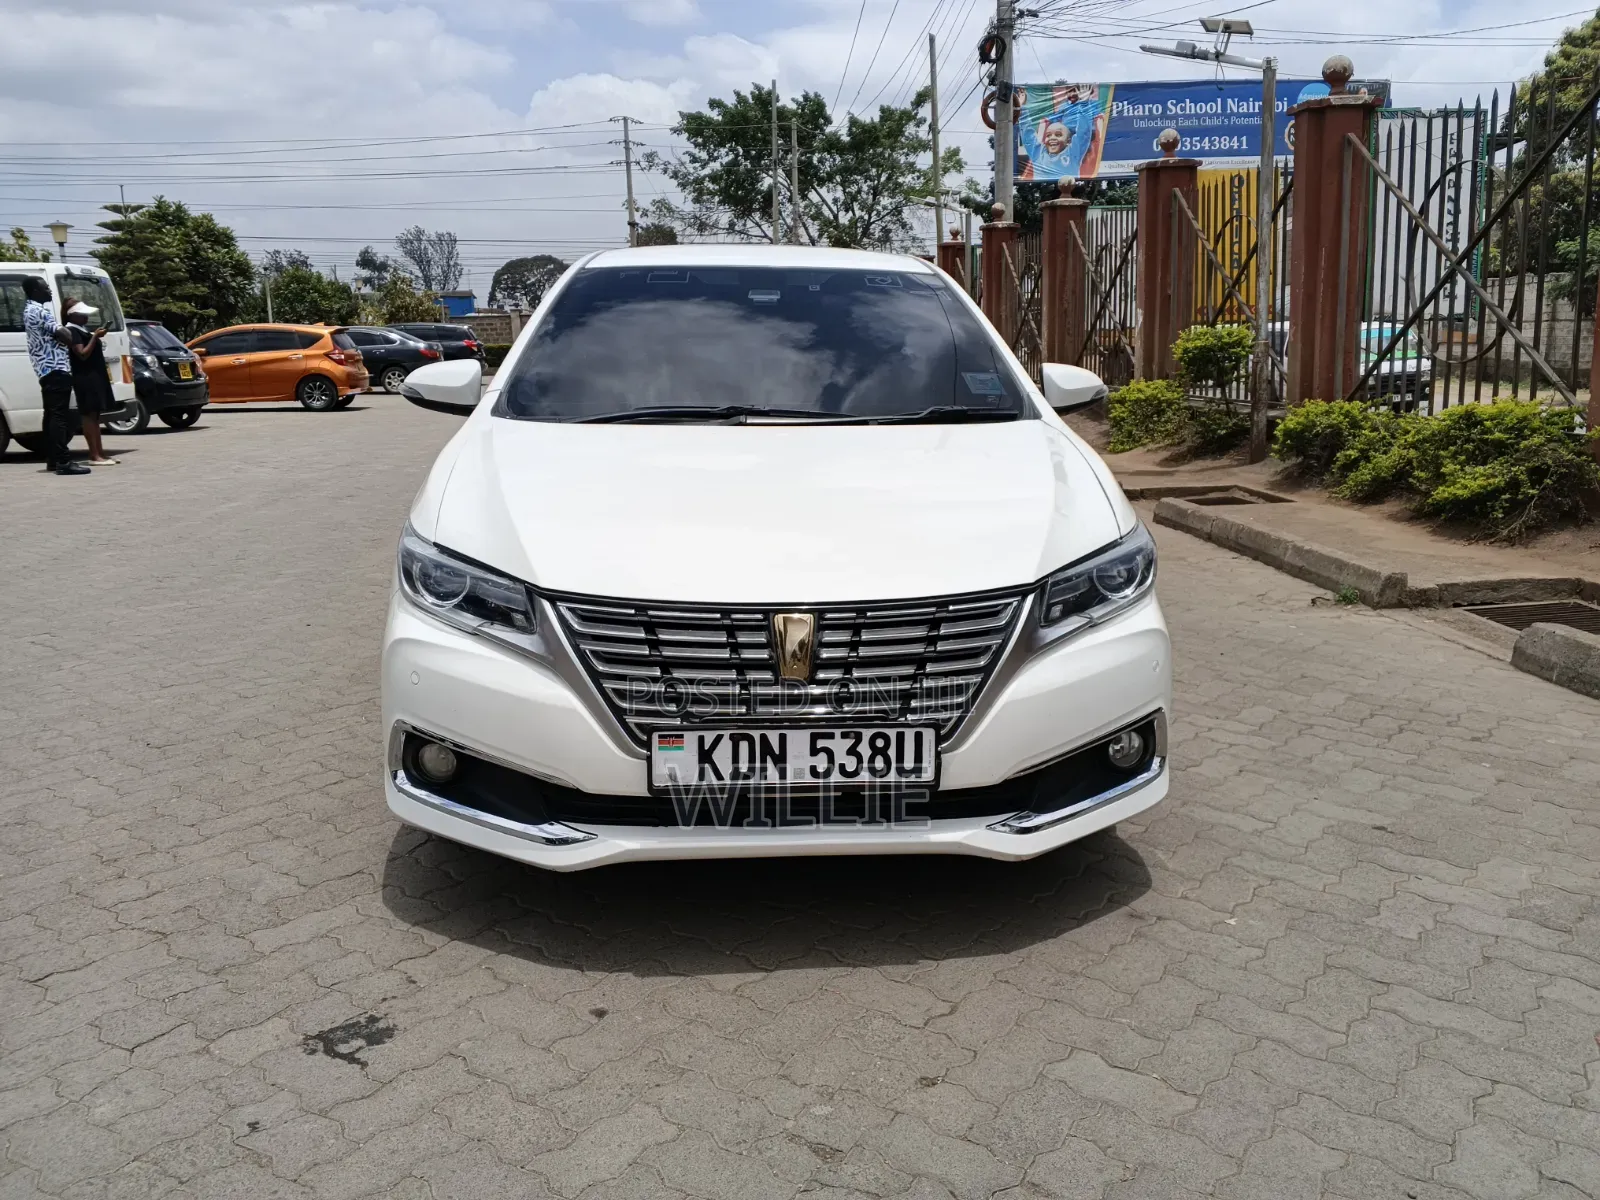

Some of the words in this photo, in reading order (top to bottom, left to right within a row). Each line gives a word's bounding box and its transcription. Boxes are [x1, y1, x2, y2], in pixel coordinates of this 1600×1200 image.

[1112, 101, 1162, 116] Pharo
[1167, 98, 1222, 115] School
[1227, 97, 1288, 113] Nairbi
[1133, 118, 1177, 129] Unlocking
[1178, 117, 1199, 126] Each
[1200, 115, 1229, 126] Child's
[1231, 115, 1263, 125] Potenti
[1153, 135, 1249, 152] 03543841
[697, 732, 788, 782] KDN
[808, 730, 924, 781] 538U
